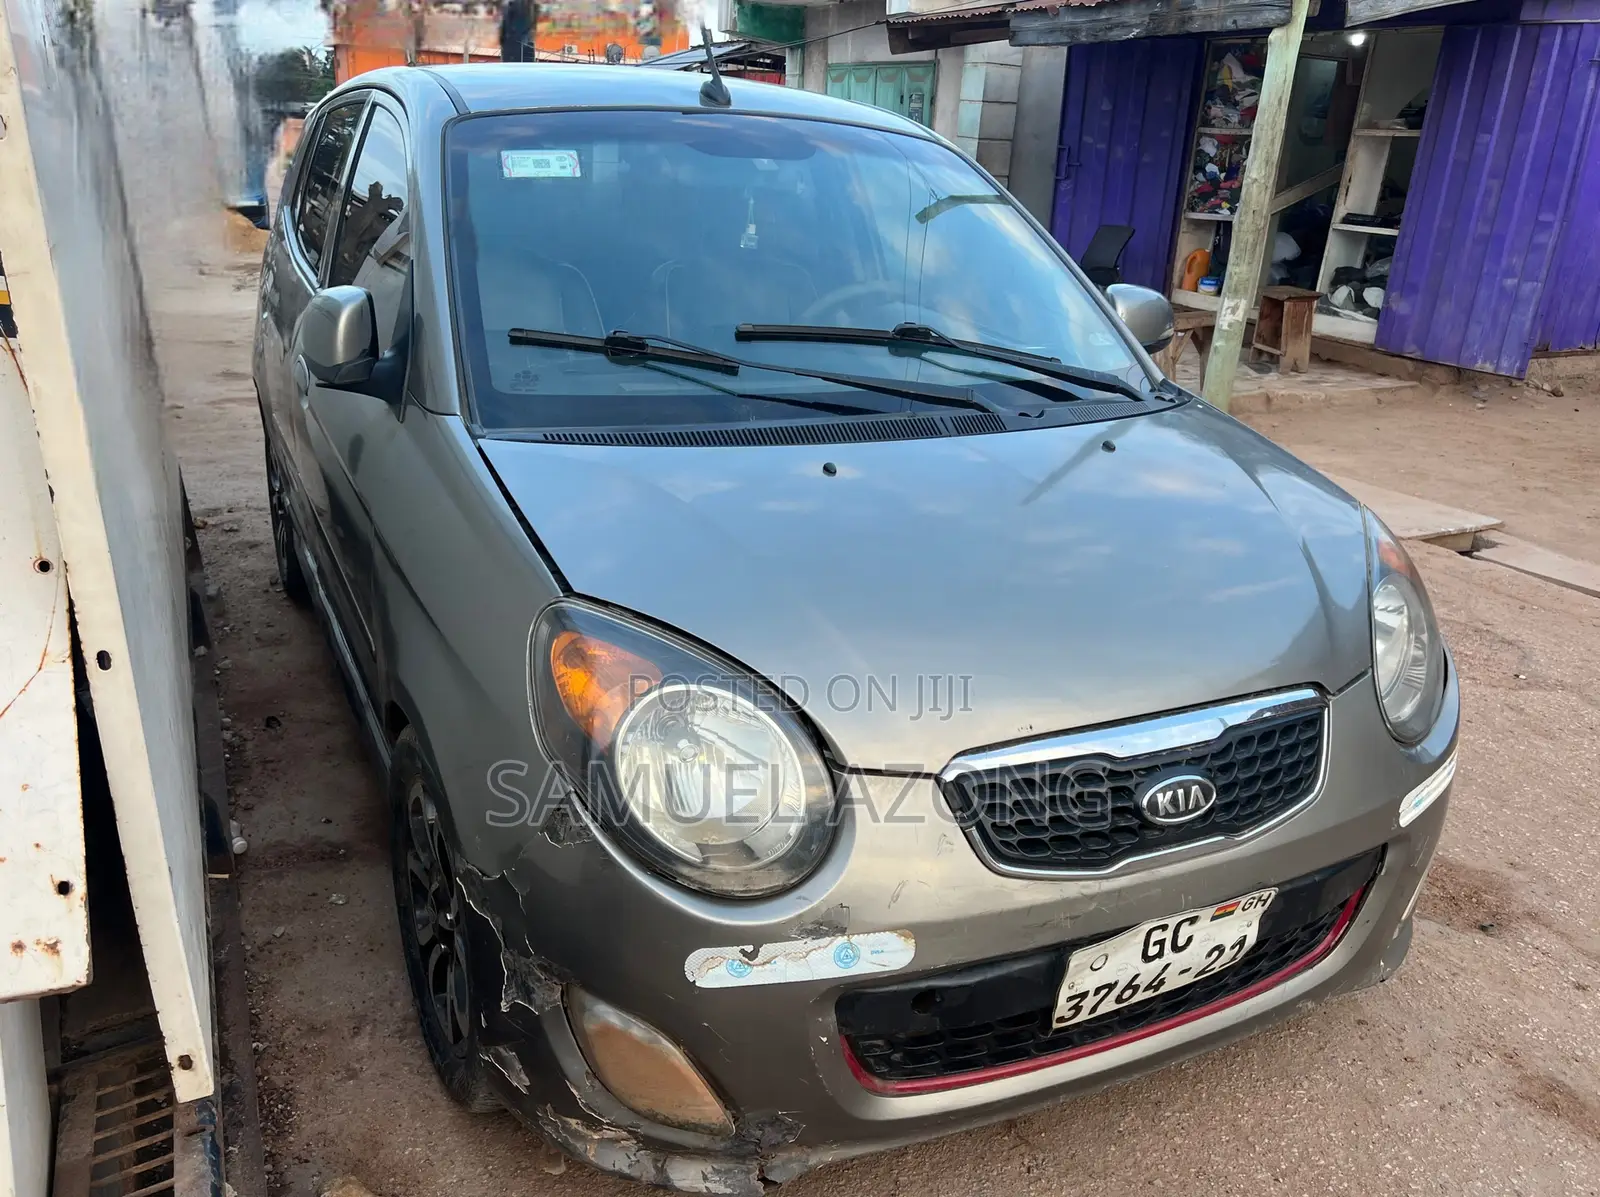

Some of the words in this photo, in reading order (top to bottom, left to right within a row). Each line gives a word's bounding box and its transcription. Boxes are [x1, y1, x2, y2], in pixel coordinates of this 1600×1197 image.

[1156, 785, 1206, 816] KIA
[1241, 892, 1272, 912] GH
[1141, 915, 1201, 963] GC
